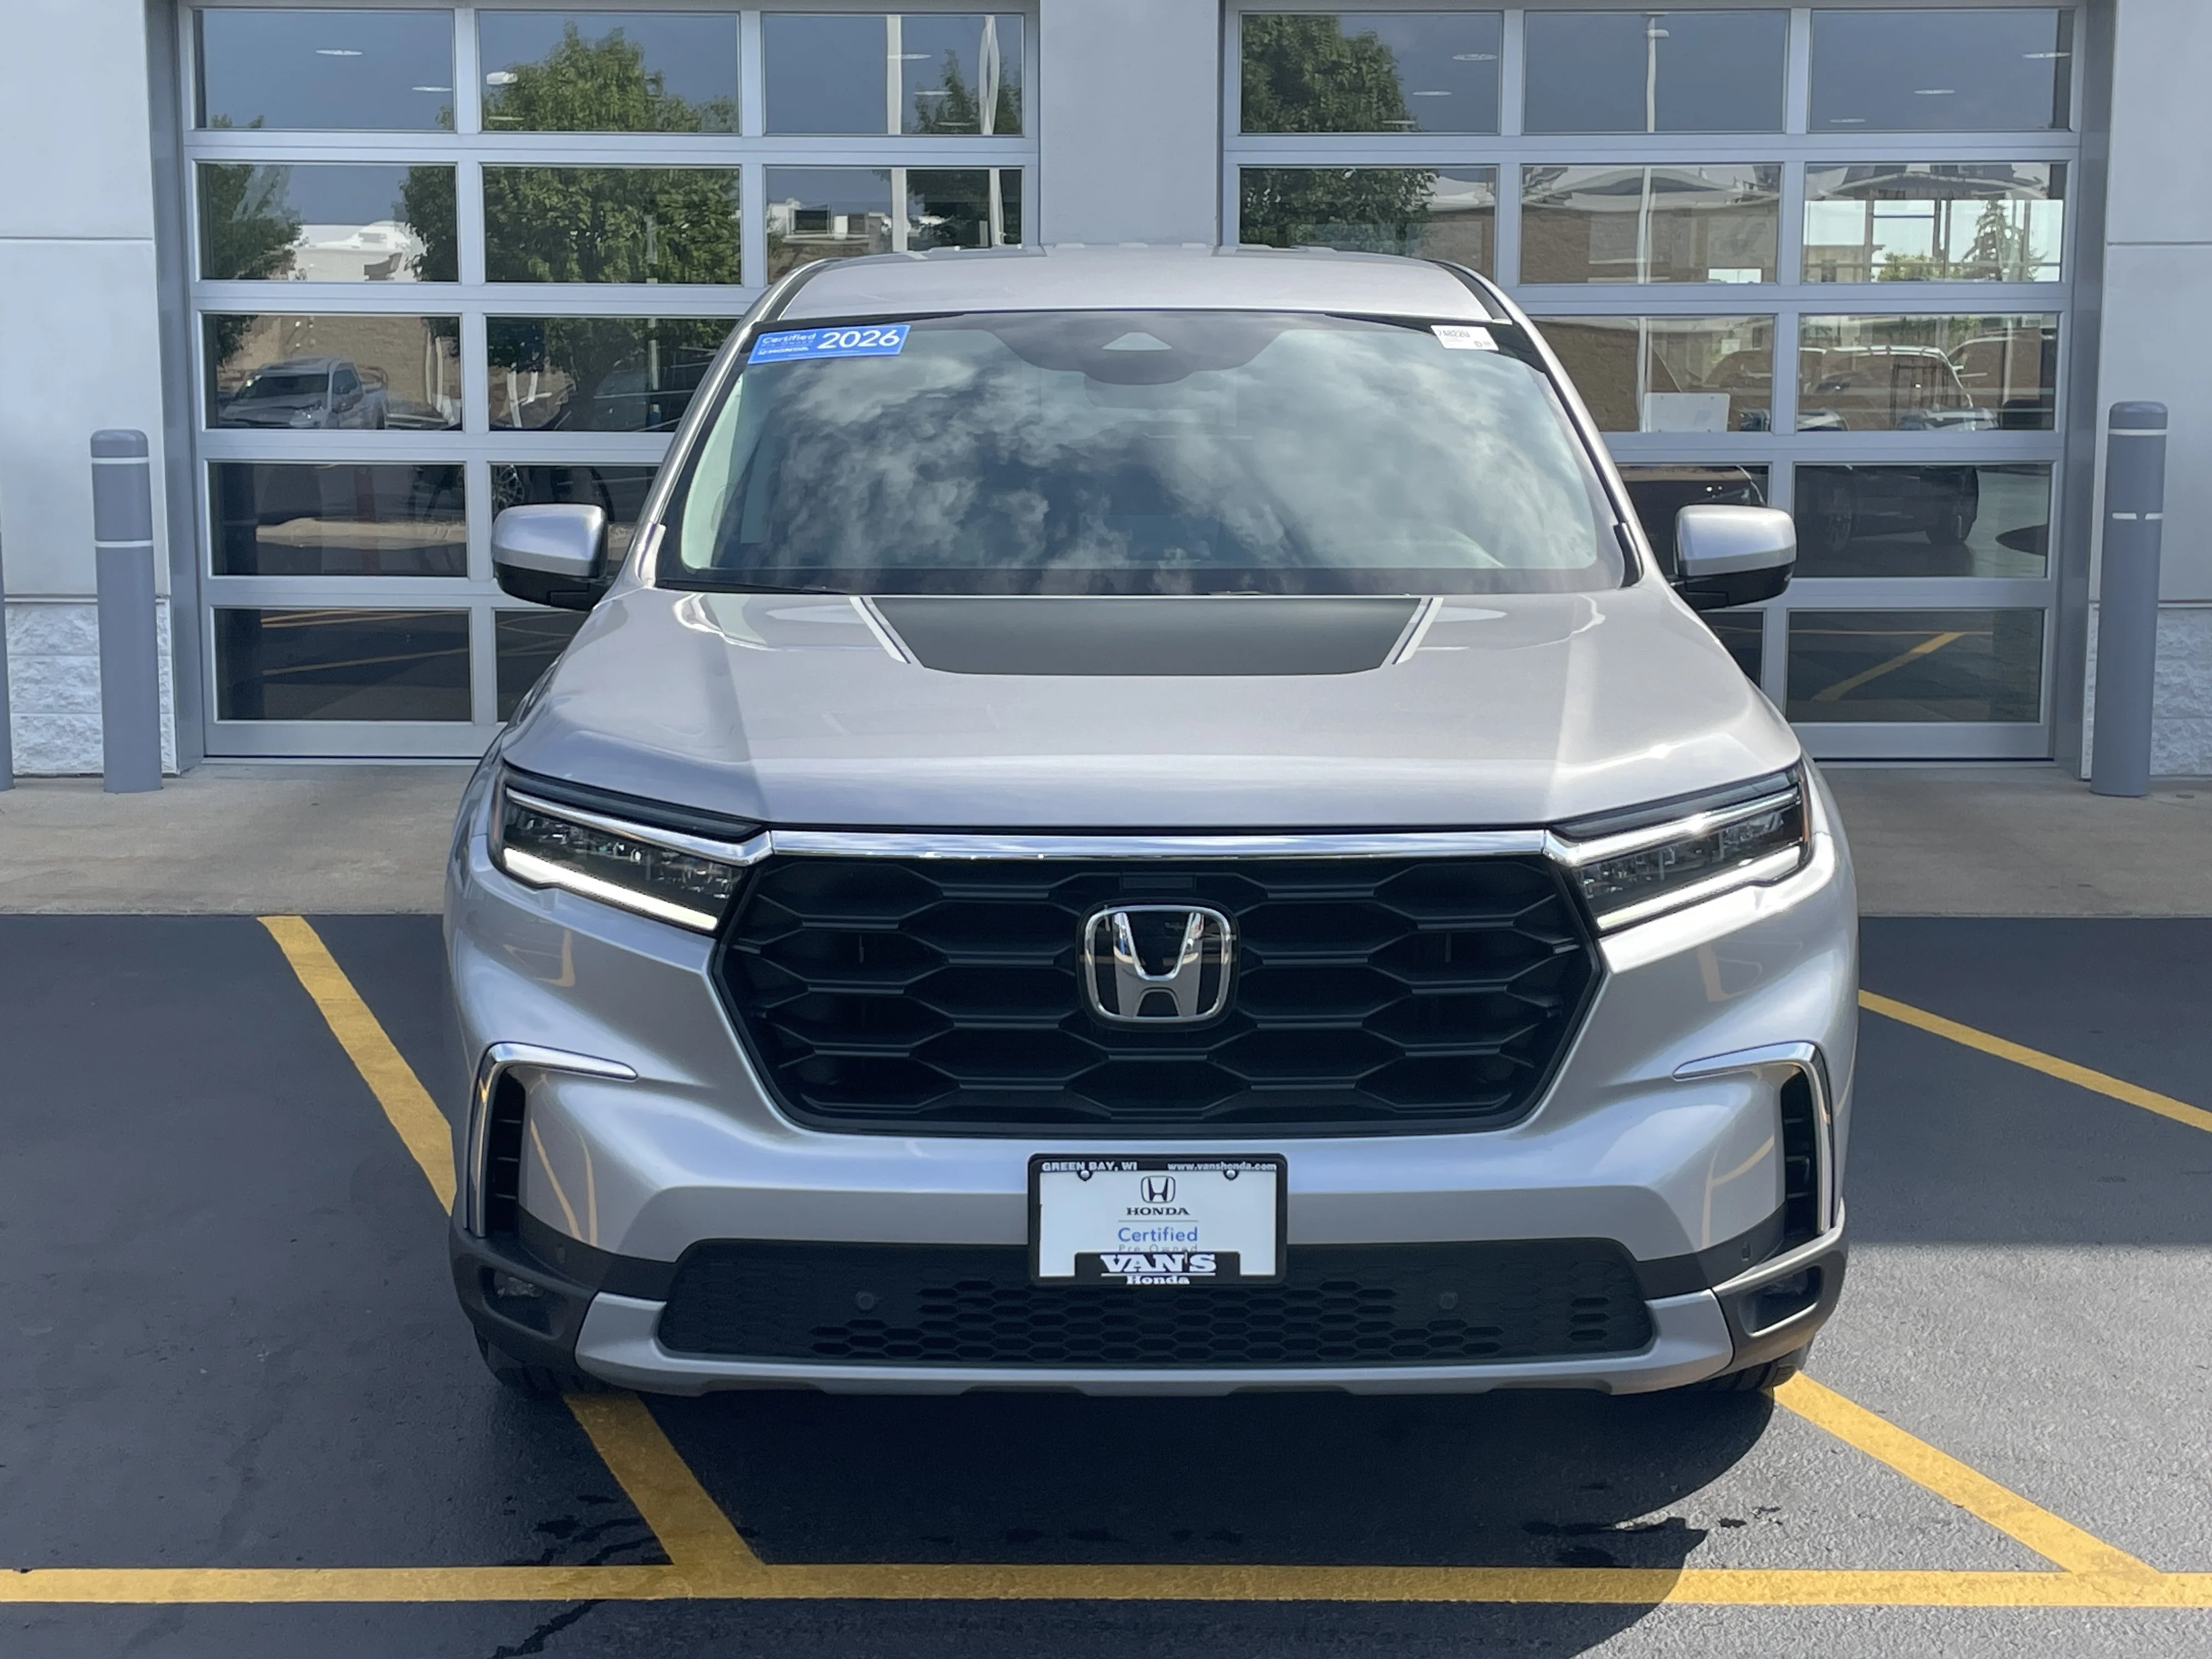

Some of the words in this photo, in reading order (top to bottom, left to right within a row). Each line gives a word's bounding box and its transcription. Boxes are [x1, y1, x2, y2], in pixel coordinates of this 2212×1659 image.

[762, 333, 816, 343] Certified
[817, 329, 900, 349] 2026
[1042, 1161, 1085, 1171] GREEN
[1088, 1161, 1119, 1172] BAY,
[1121, 1161, 1138, 1171] WI
[1167, 1160, 1277, 1171] www.vanshonda.com
[1126, 1207, 1190, 1216] HONDA
[1118, 1226, 1198, 1243] Certified
[1118, 1244, 1198, 1252] Pre-Owned
[1099, 1250, 1217, 1273] VAN'S
[1126, 1276, 1190, 1285] Honda
